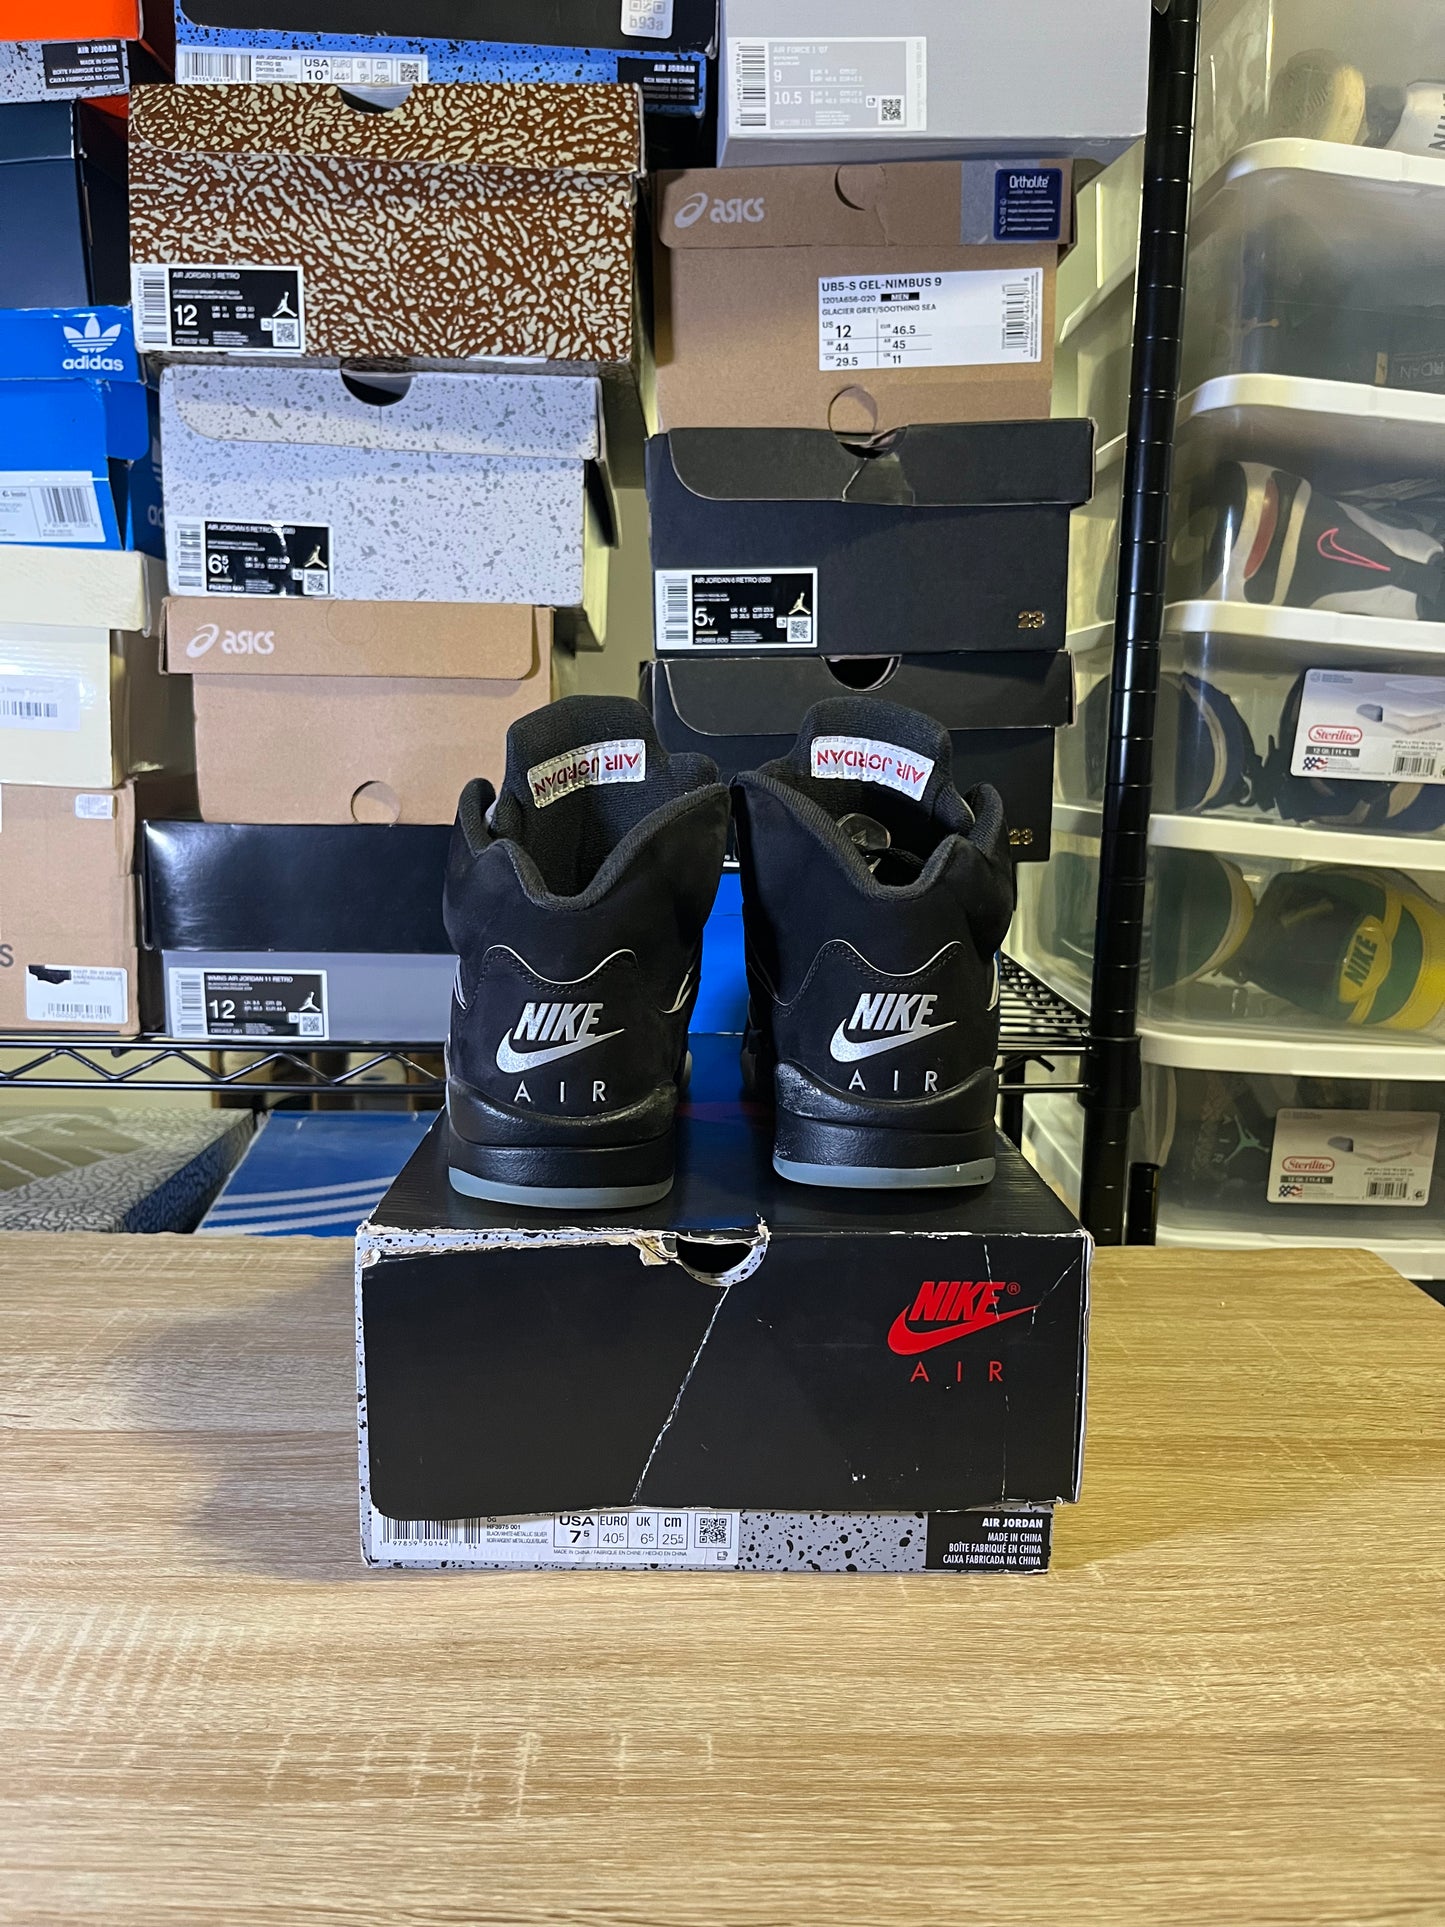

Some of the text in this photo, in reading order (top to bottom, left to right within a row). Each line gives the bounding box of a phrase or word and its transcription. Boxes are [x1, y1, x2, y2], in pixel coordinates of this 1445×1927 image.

[91, 44, 117, 54] JORDAN
[304, 59, 329, 67] USA
[333, 59, 351, 68] EURO
[356, 60, 367, 69] UK
[667, 64, 695, 73] JORDAN
[774, 69, 782, 83] 9
[774, 91, 802, 105] 10.5
[709, 197, 764, 224] asics
[172, 271, 184, 279] AIR
[184, 271, 211, 279] JORDAN
[217, 272, 240, 280] RETRO
[822, 277, 942, 292] UB5-S GEL-NIMBUS 9
[174, 304, 198, 326] 12
[822, 303, 936, 316] GLACIER GREY/SOOTHING SEA
[822, 321, 834, 329] US
[835, 324, 852, 338] 12
[892, 325, 916, 335] 46.5
[835, 340, 906, 352] 44 45
[62, 354, 124, 371] adidas
[835, 356, 859, 367] 29.5
[893, 355, 901, 364] 11
[694, 607, 715, 627] 5 Y
[1018, 610, 1045, 629] 23
[221, 630, 275, 655] asics
[1313, 729, 1354, 741] Sterilite
[533, 753, 639, 797] AIR JORDAN
[817, 749, 925, 784] AIR JORDAN
[1009, 828, 1033, 845] 23
[1343, 934, 1378, 988] NIKE
[209, 999, 236, 1019] 12
[849, 993, 938, 1032] NIKE
[513, 1002, 604, 1041] NIKE
[848, 1068, 940, 1092] AIR
[513, 1080, 608, 1102] AIR
[1287, 1159, 1327, 1170] Sterilite
[908, 1281, 1006, 1321] NIKE
[910, 1360, 1004, 1383] AIR
[559, 1515, 682, 1528] USA EURO UK cm
[982, 1517, 1043, 1528] AIR JORDAN
[987, 1532, 1042, 1543] MADE IN CHINA
[949, 1541, 1042, 1554] BOÎTE FABRIQUÉ EN CHINA
[942, 1554, 1041, 1565] CAIXA FABRICADA NA CHINA
